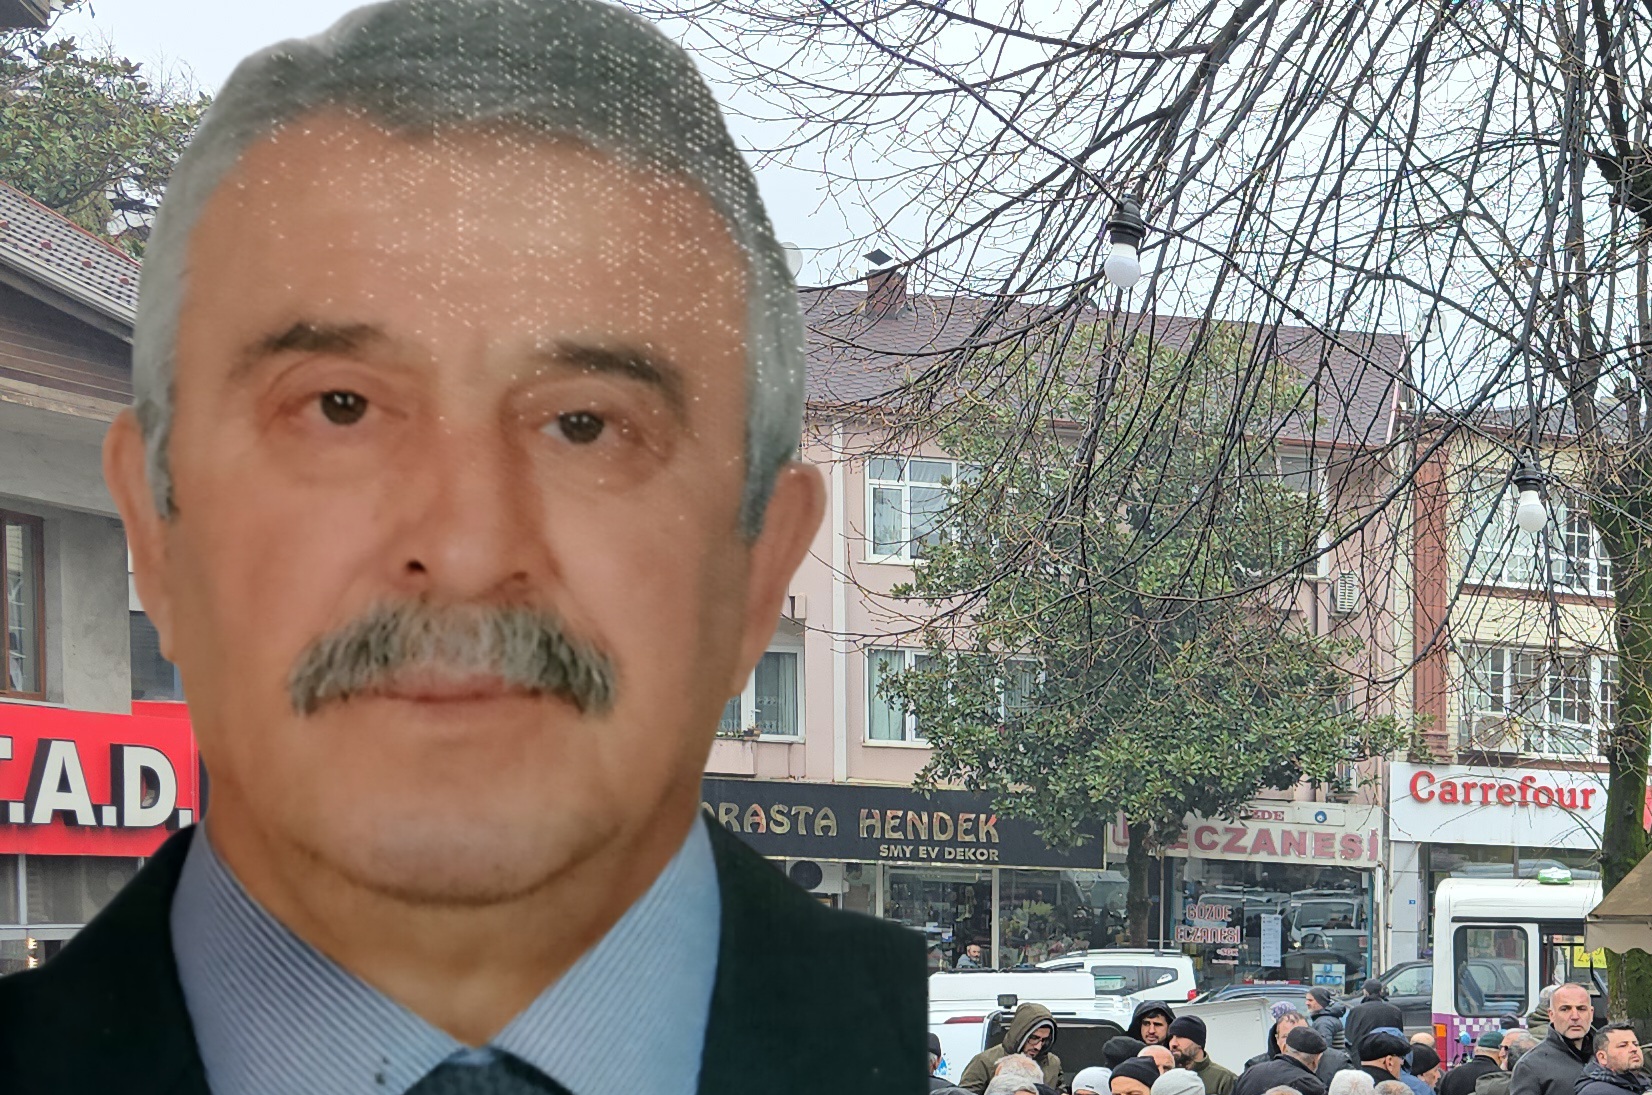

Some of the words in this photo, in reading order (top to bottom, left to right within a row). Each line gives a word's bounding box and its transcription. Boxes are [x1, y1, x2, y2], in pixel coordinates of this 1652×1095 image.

[0, 737, 193, 830] .A.D.
[1409, 770, 1597, 810] Carrefour
[859, 808, 1000, 843] HENDEK
[879, 844, 912, 859] SMY
[918, 845, 941, 860] EV
[944, 846, 1000, 862] DEKOR
[1186, 903, 1233, 922] GÖZDE
[1175, 925, 1241, 945] ECZANESİ
